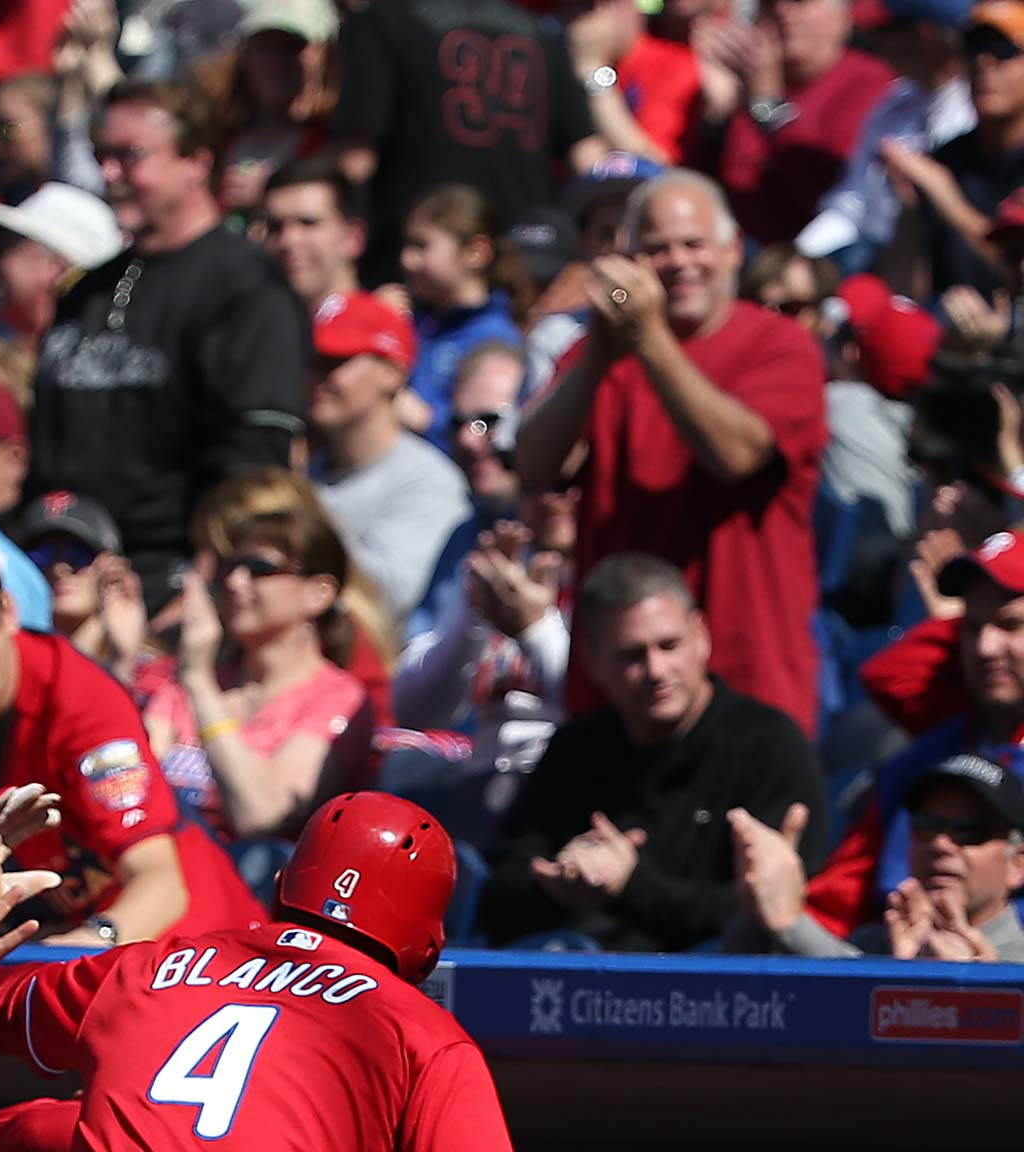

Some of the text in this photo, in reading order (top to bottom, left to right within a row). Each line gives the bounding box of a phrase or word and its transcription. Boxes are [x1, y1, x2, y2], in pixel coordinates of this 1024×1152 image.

[438, 27, 549, 152] 39
[334, 868, 361, 899] 4
[151, 948, 379, 1004] BLANCO
[571, 989, 786, 1030] Citizens Bank Park
[147, 1003, 281, 1140] 4
